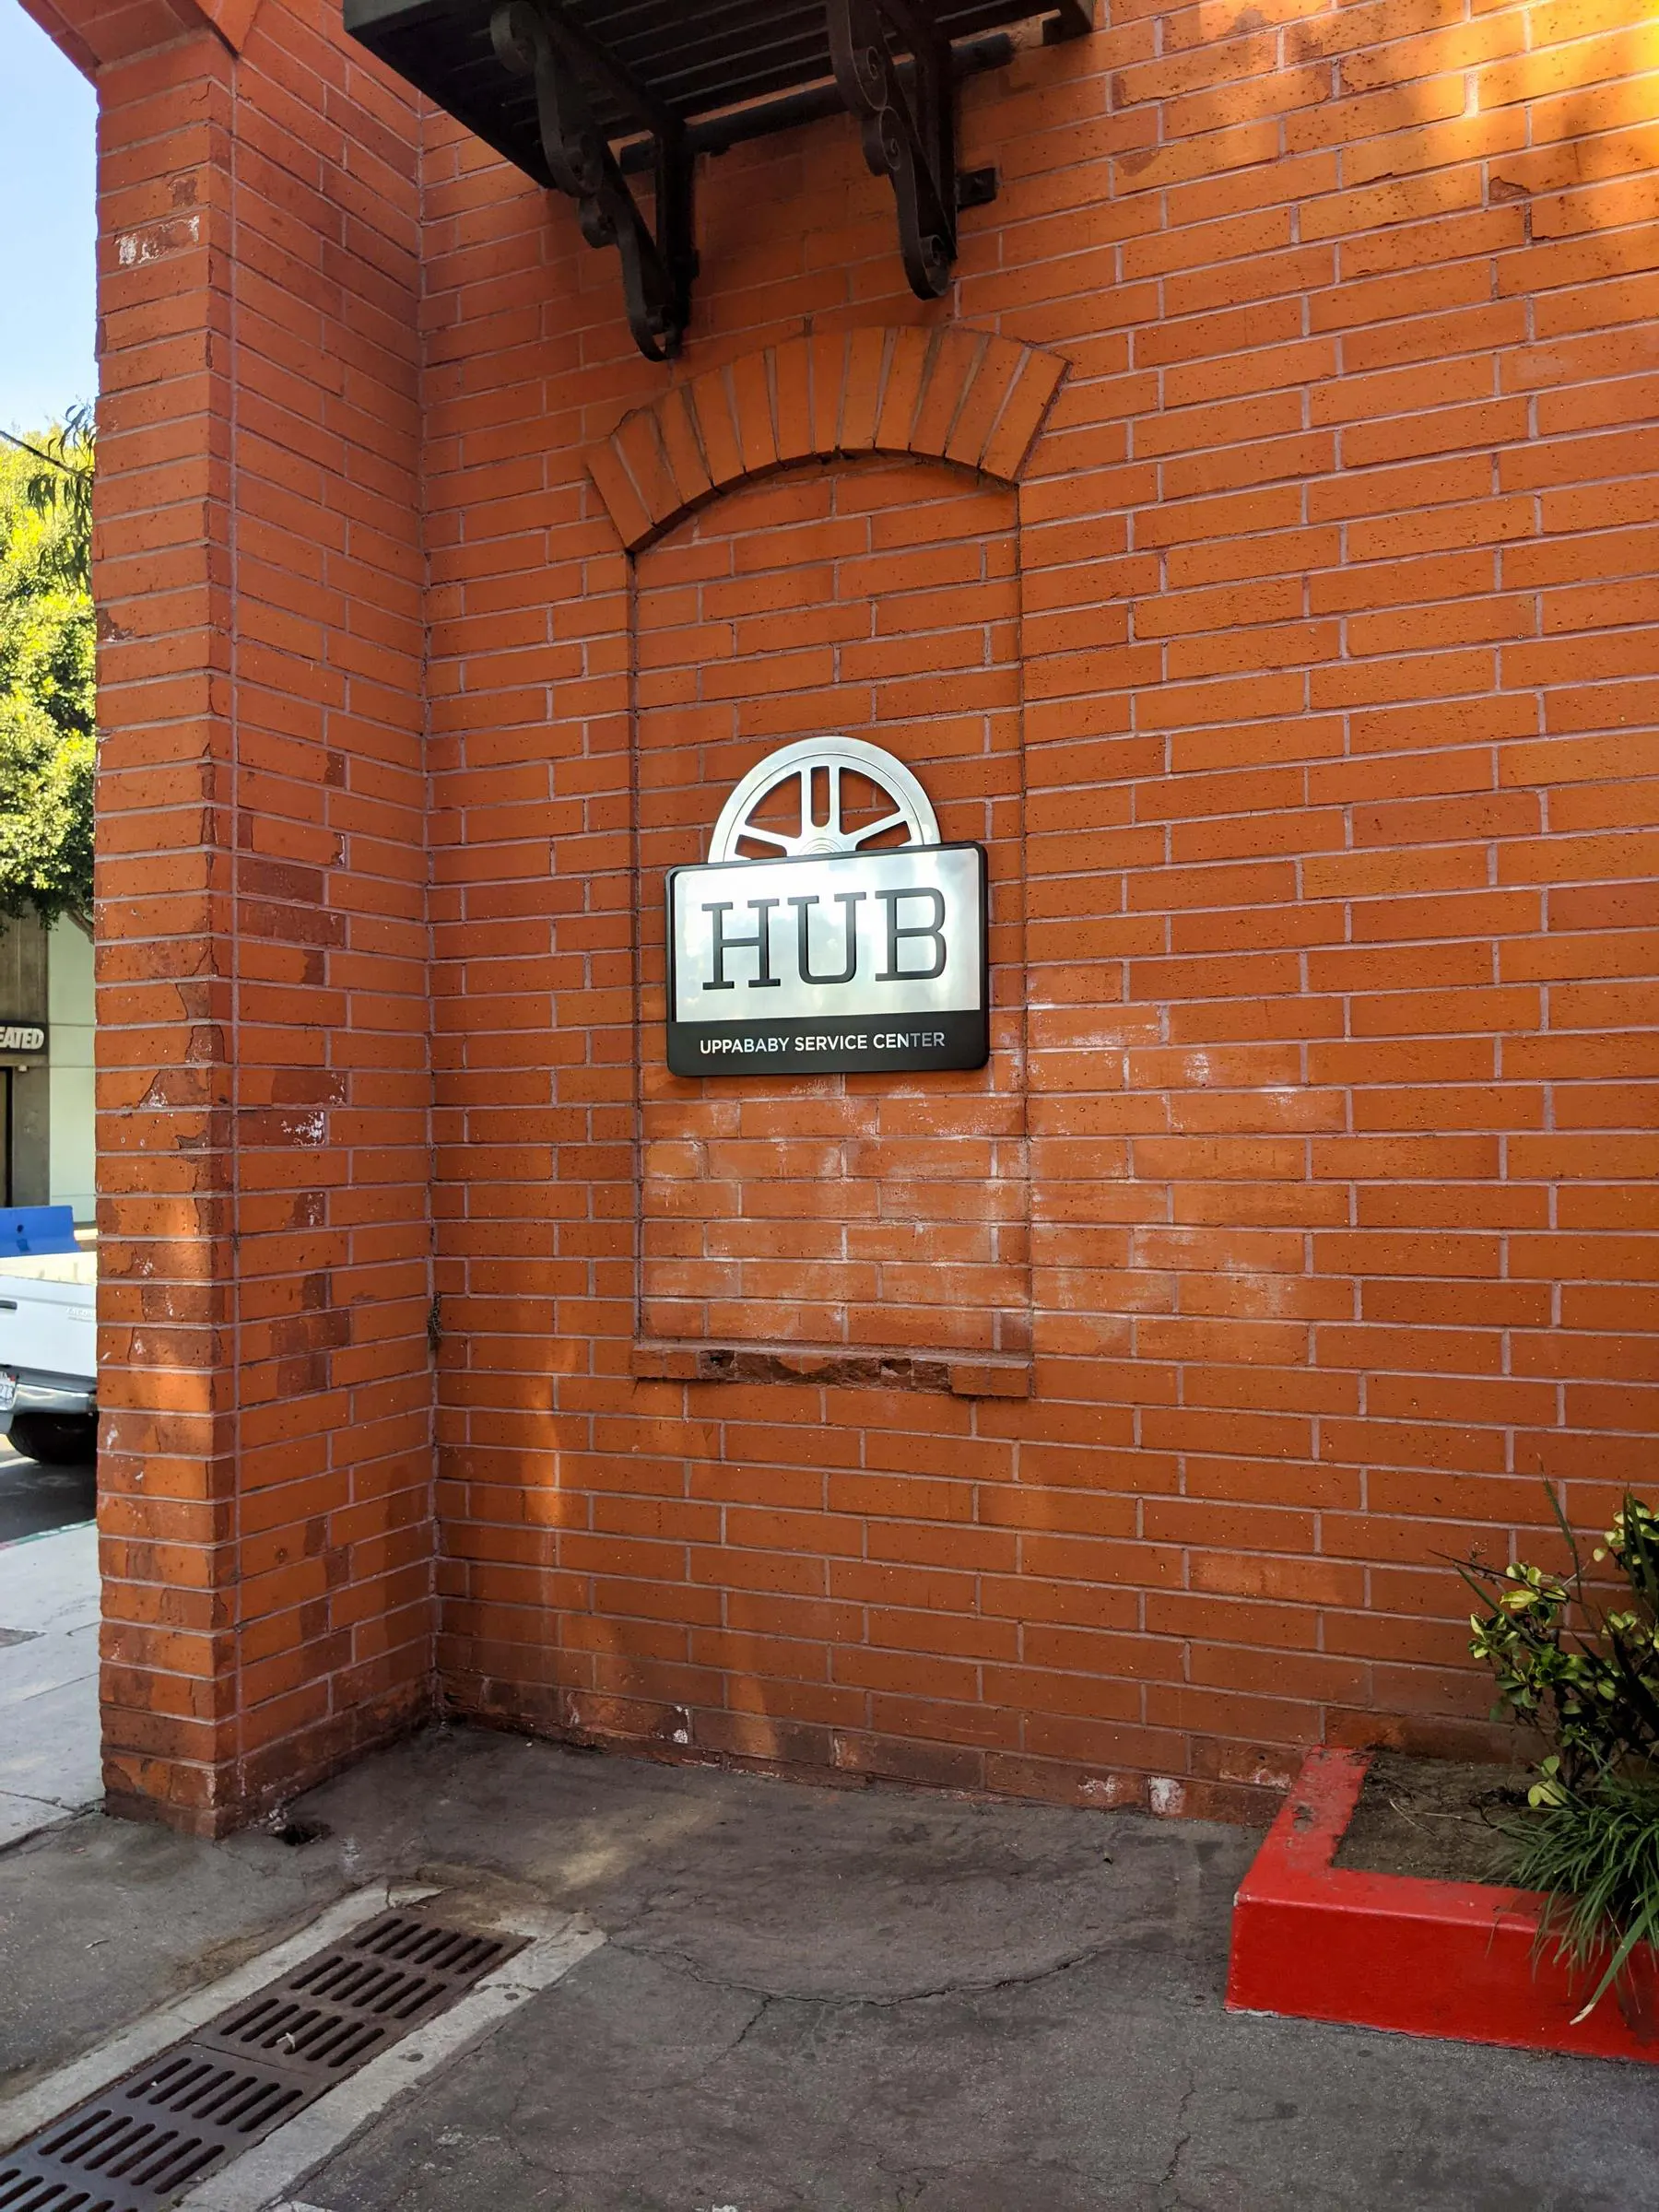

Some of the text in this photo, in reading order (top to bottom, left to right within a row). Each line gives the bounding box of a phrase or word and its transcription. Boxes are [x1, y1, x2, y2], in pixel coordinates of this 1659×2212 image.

[701, 887, 947, 991] HUB
[700, 1031, 946, 1054] UPPABABY SERVICE CENTER
